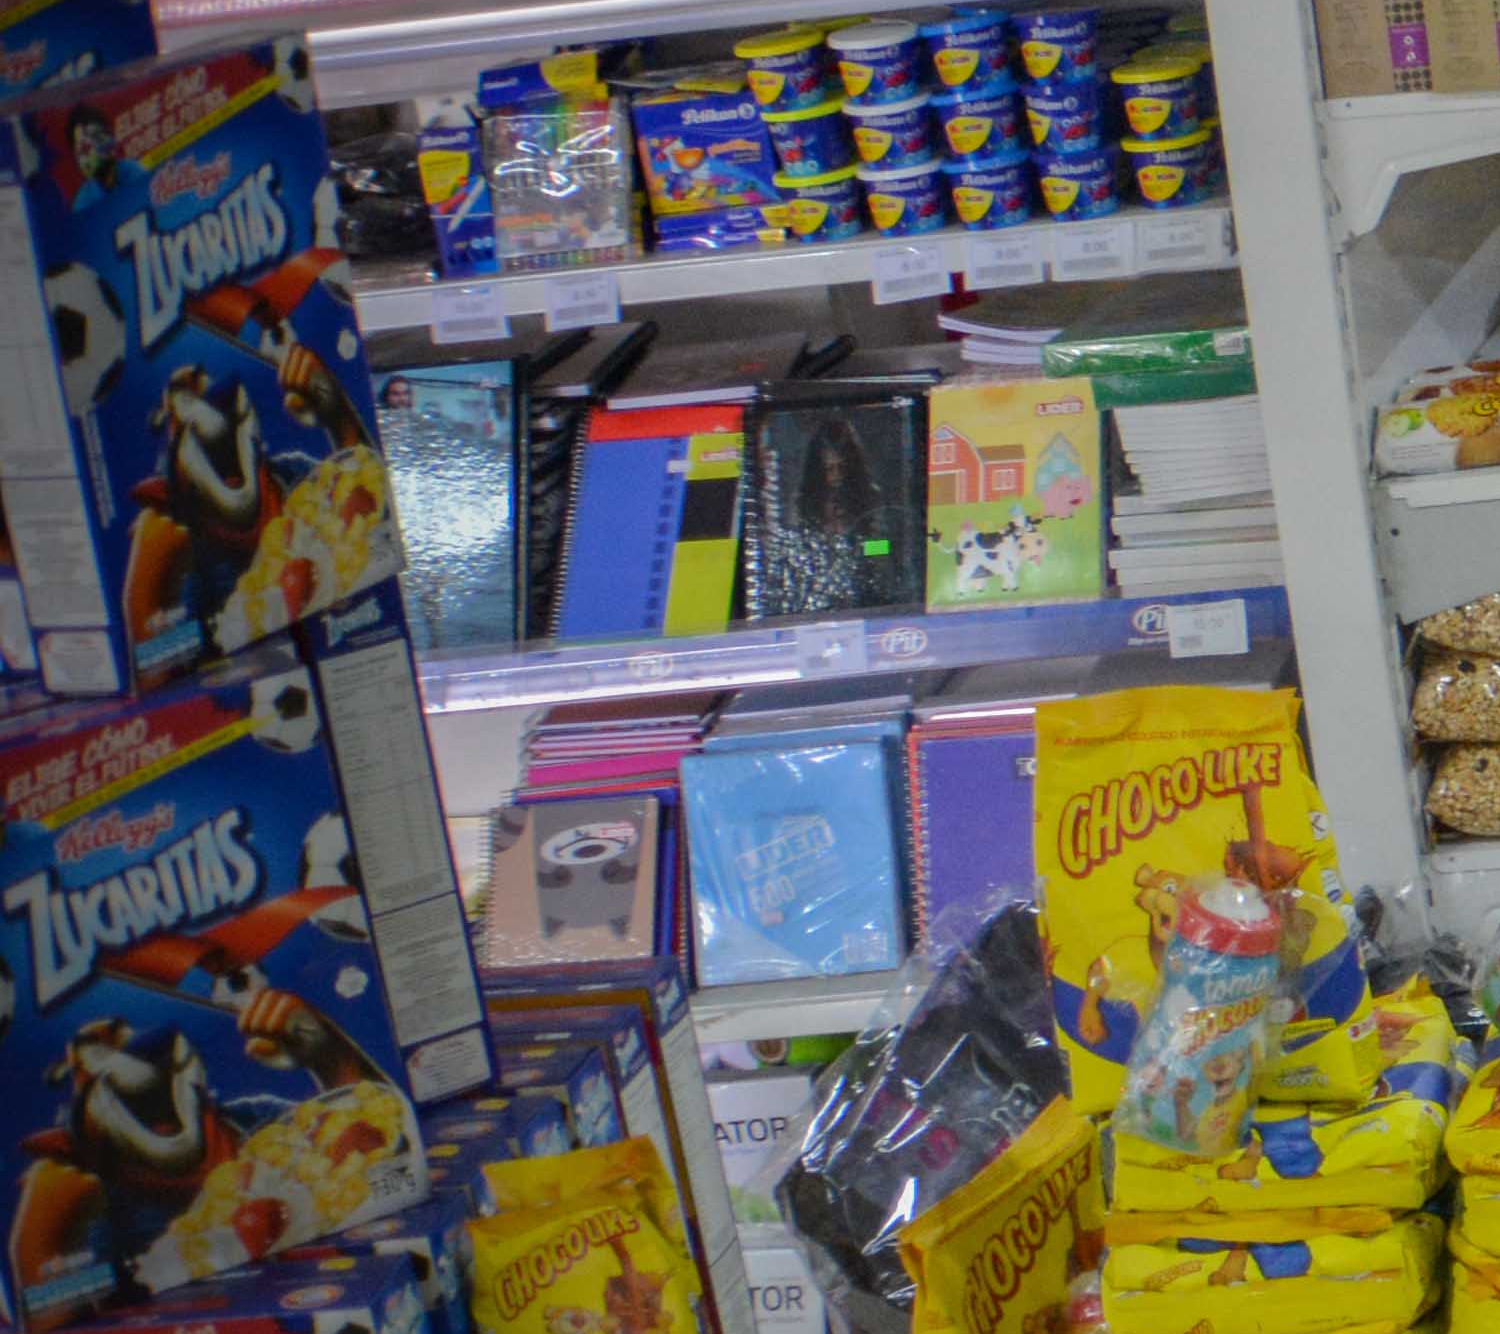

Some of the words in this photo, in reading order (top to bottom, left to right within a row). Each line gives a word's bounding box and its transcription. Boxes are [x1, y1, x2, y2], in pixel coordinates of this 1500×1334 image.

[681, 109, 738, 125] Pelikan
[118, 165, 290, 349] ZUCARITAS
[1036, 401, 1083, 417] LIDER
[56, 805, 175, 859] Kellogg's
[1056, 743, 1286, 879] CHOCOLIKE
[4, 806, 259, 1011] ZUCARITAS
[494, 1205, 643, 1322] CHOCOLIKE
